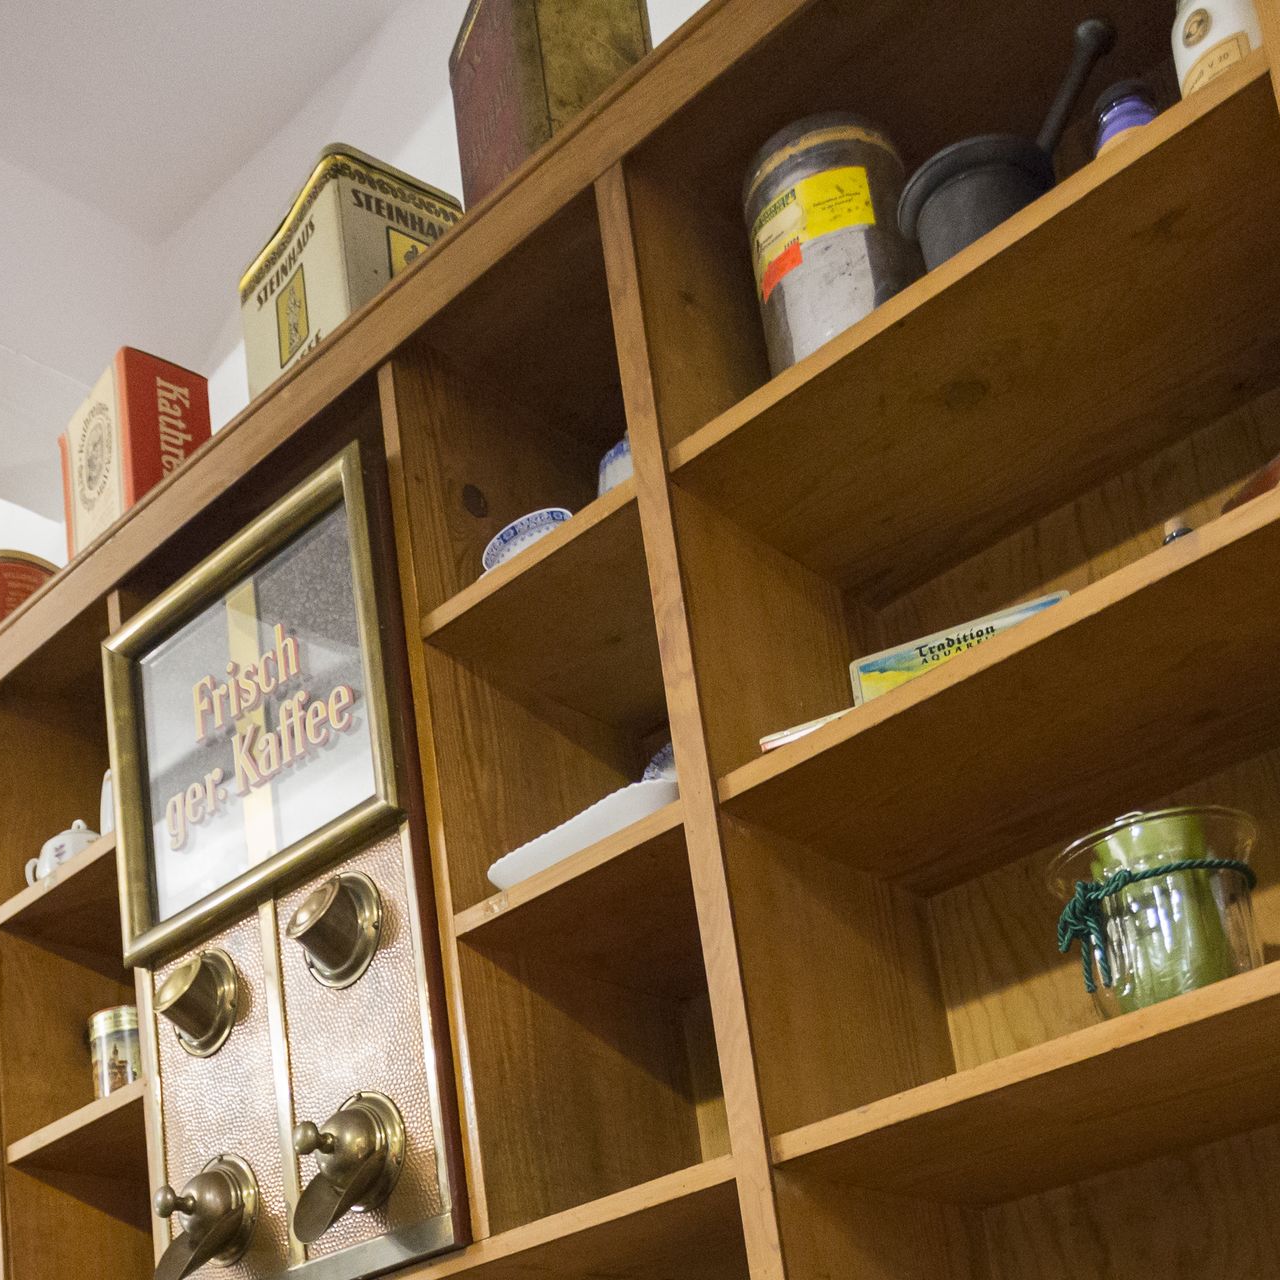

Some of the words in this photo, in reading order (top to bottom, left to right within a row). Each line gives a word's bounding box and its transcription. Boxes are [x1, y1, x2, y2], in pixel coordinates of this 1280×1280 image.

[256, 214, 316, 311] STEINHAUS
[156, 376, 193, 479] Kathre
[193, 623, 301, 743] Frisch
[915, 624, 995, 658] Tradition
[166, 767, 227, 851] ger.
[232, 684, 355, 797] Kaffee
